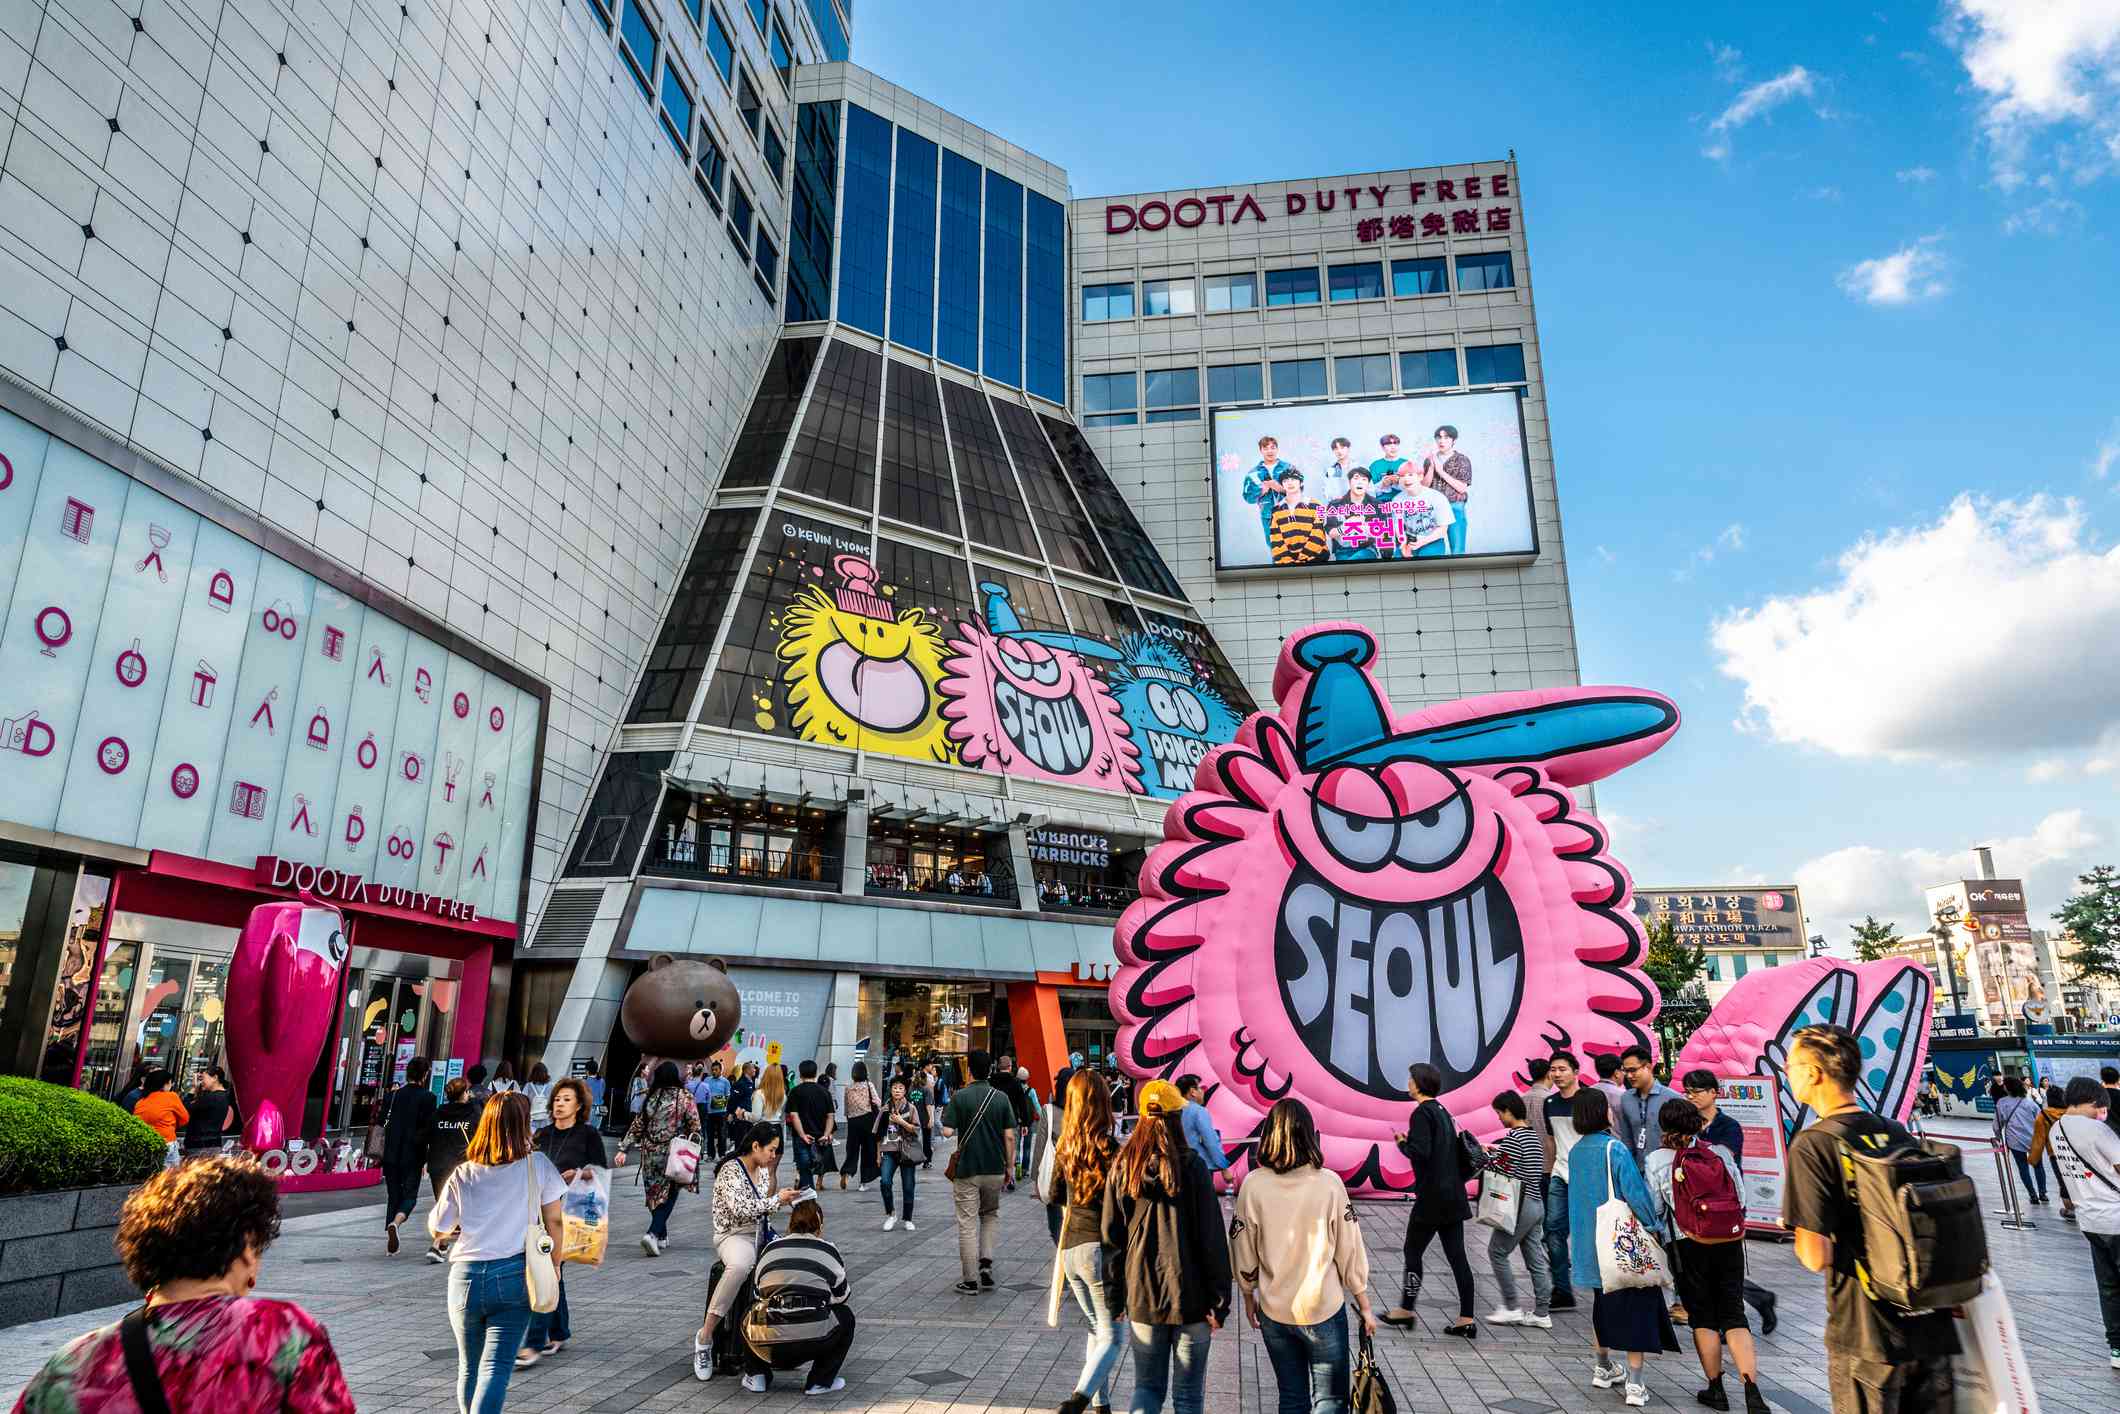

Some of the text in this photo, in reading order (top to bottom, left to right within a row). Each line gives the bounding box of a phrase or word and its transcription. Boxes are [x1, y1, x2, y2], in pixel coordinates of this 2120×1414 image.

[1106, 174, 1510, 235] DOOTA DUTY FREE
[798, 527, 832, 545] KEVIN
[835, 537, 870, 556] LYONS
[1342, 517, 1406, 549] 주헌!
[1149, 621, 1206, 647] DOOTA
[996, 681, 1092, 772] SEOUL
[1028, 845, 1109, 867] TARBUCKS
[272, 857, 368, 904] DOOTA
[379, 884, 433, 911] DUTY
[1655, 896, 1741, 910] 평화시장
[1969, 892, 1986, 901] OK
[1699, 924, 1742, 932] FASHION
[1743, 923, 1778, 932] PLAZA
[740, 990, 800, 1003] LCOME TO
[1285, 883, 1518, 1092] SEOUL
[750, 1004, 800, 1017] FRIENDS
[438, 1121, 470, 1130] CELINE
